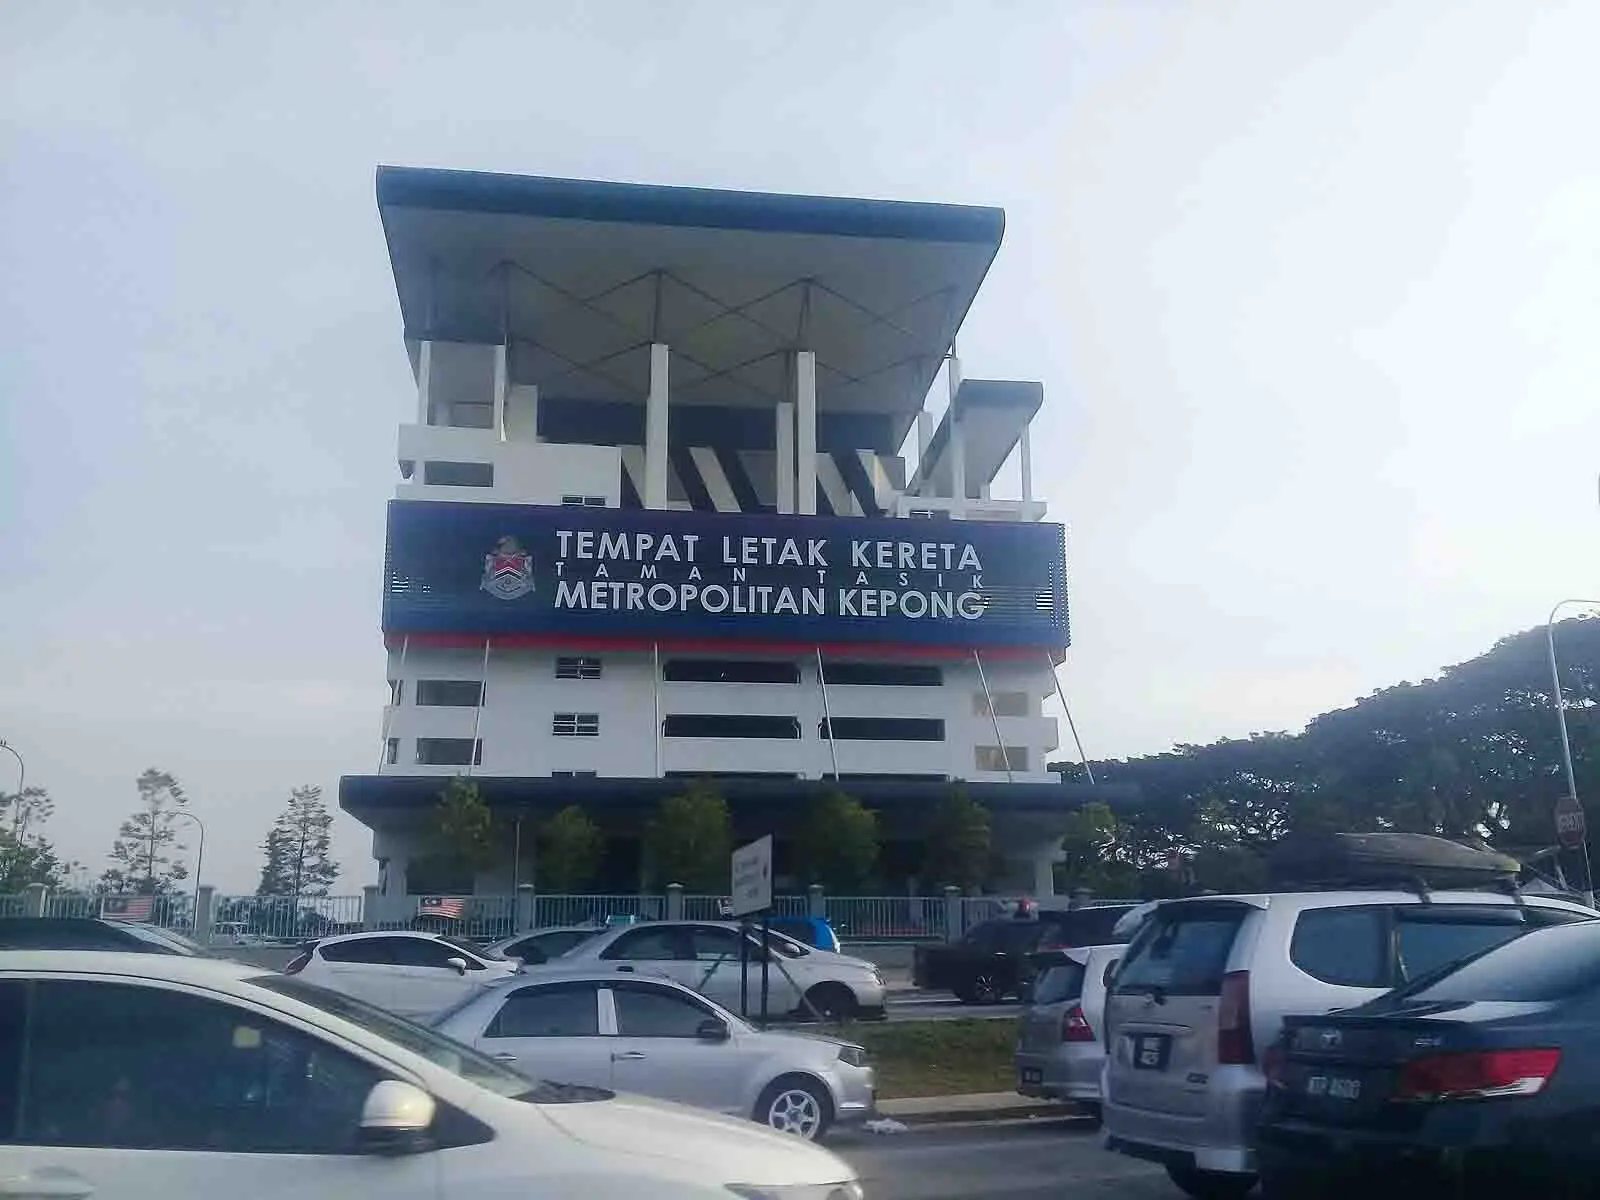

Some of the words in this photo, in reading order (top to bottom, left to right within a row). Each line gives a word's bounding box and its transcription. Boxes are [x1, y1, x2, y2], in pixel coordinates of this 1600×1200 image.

[556, 530, 699, 562] TEMPAT
[723, 536, 828, 566] LETAK
[852, 540, 983, 571] KERETA
[556, 561, 745, 582] TAMAN
[817, 569, 984, 589] TASIK
[554, 581, 825, 614] METROPOLITAN
[839, 588, 985, 620] KEPONG
